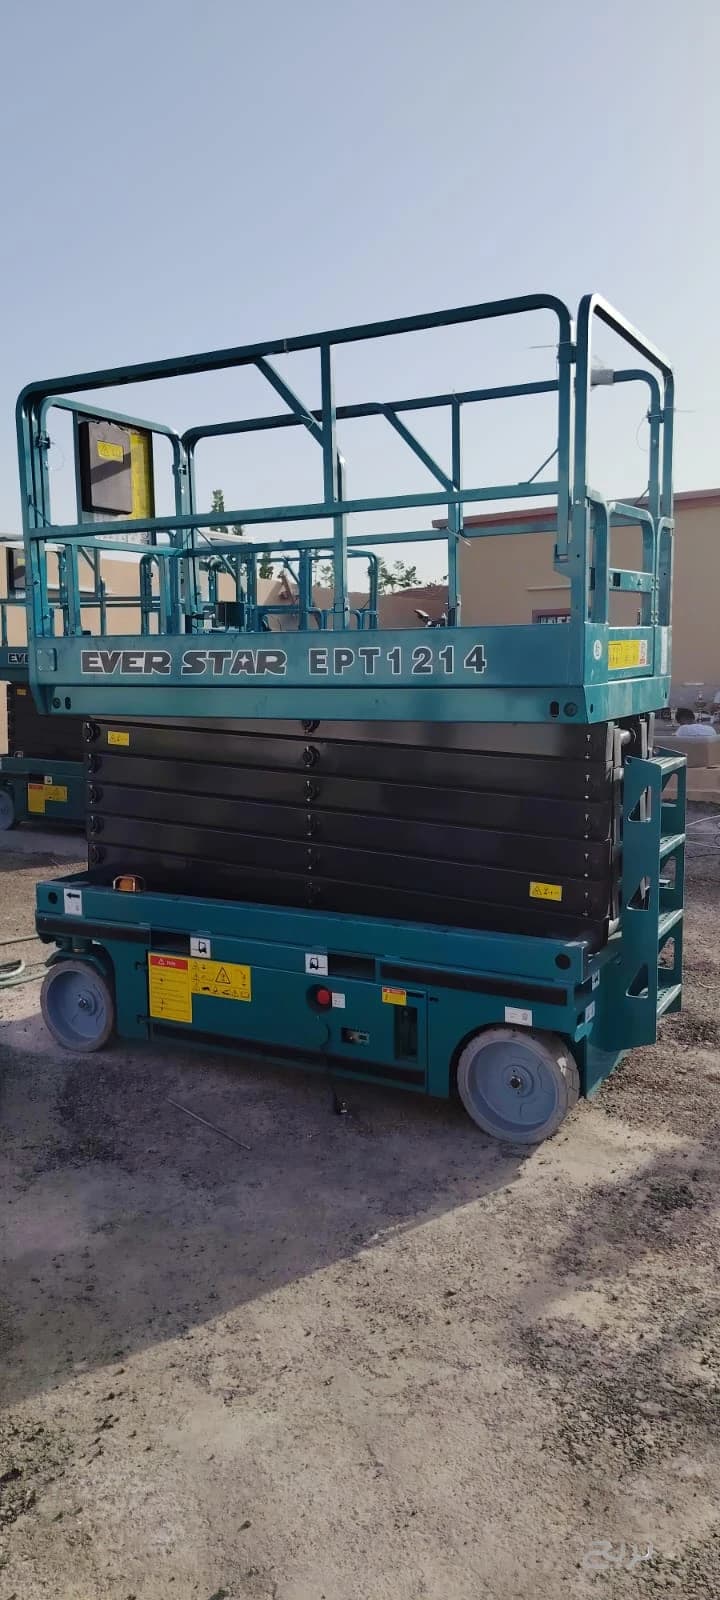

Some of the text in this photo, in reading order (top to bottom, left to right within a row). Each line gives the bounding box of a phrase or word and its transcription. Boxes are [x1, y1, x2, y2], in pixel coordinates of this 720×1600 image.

[81, 644, 487, 676] EVER STAR EPT1214
